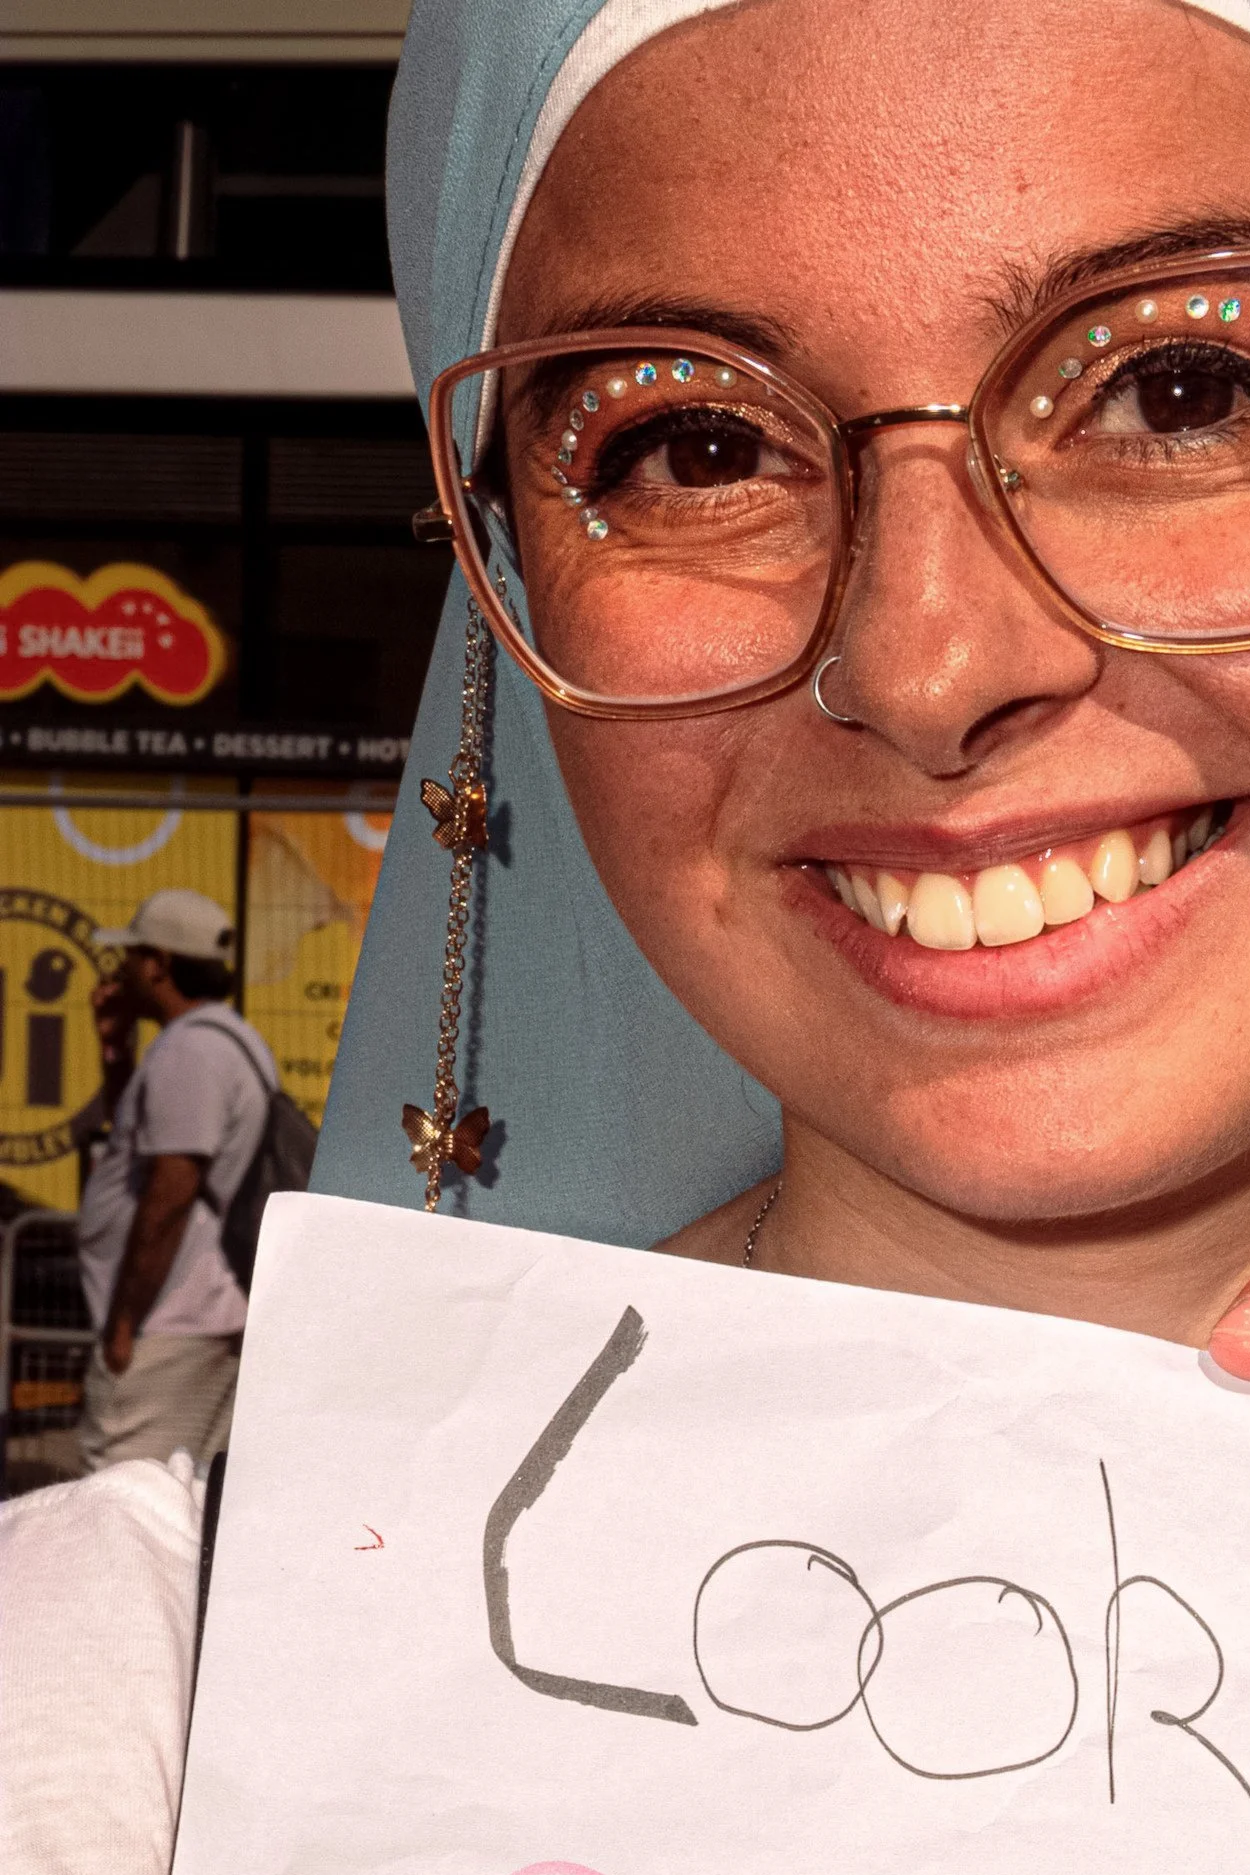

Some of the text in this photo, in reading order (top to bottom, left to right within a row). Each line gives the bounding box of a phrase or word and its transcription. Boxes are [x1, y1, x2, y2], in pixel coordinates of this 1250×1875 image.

[27, 726, 129, 755] BUBBLE
[136, 729, 188, 757] TEA
[212, 732, 333, 761] DESSERT
